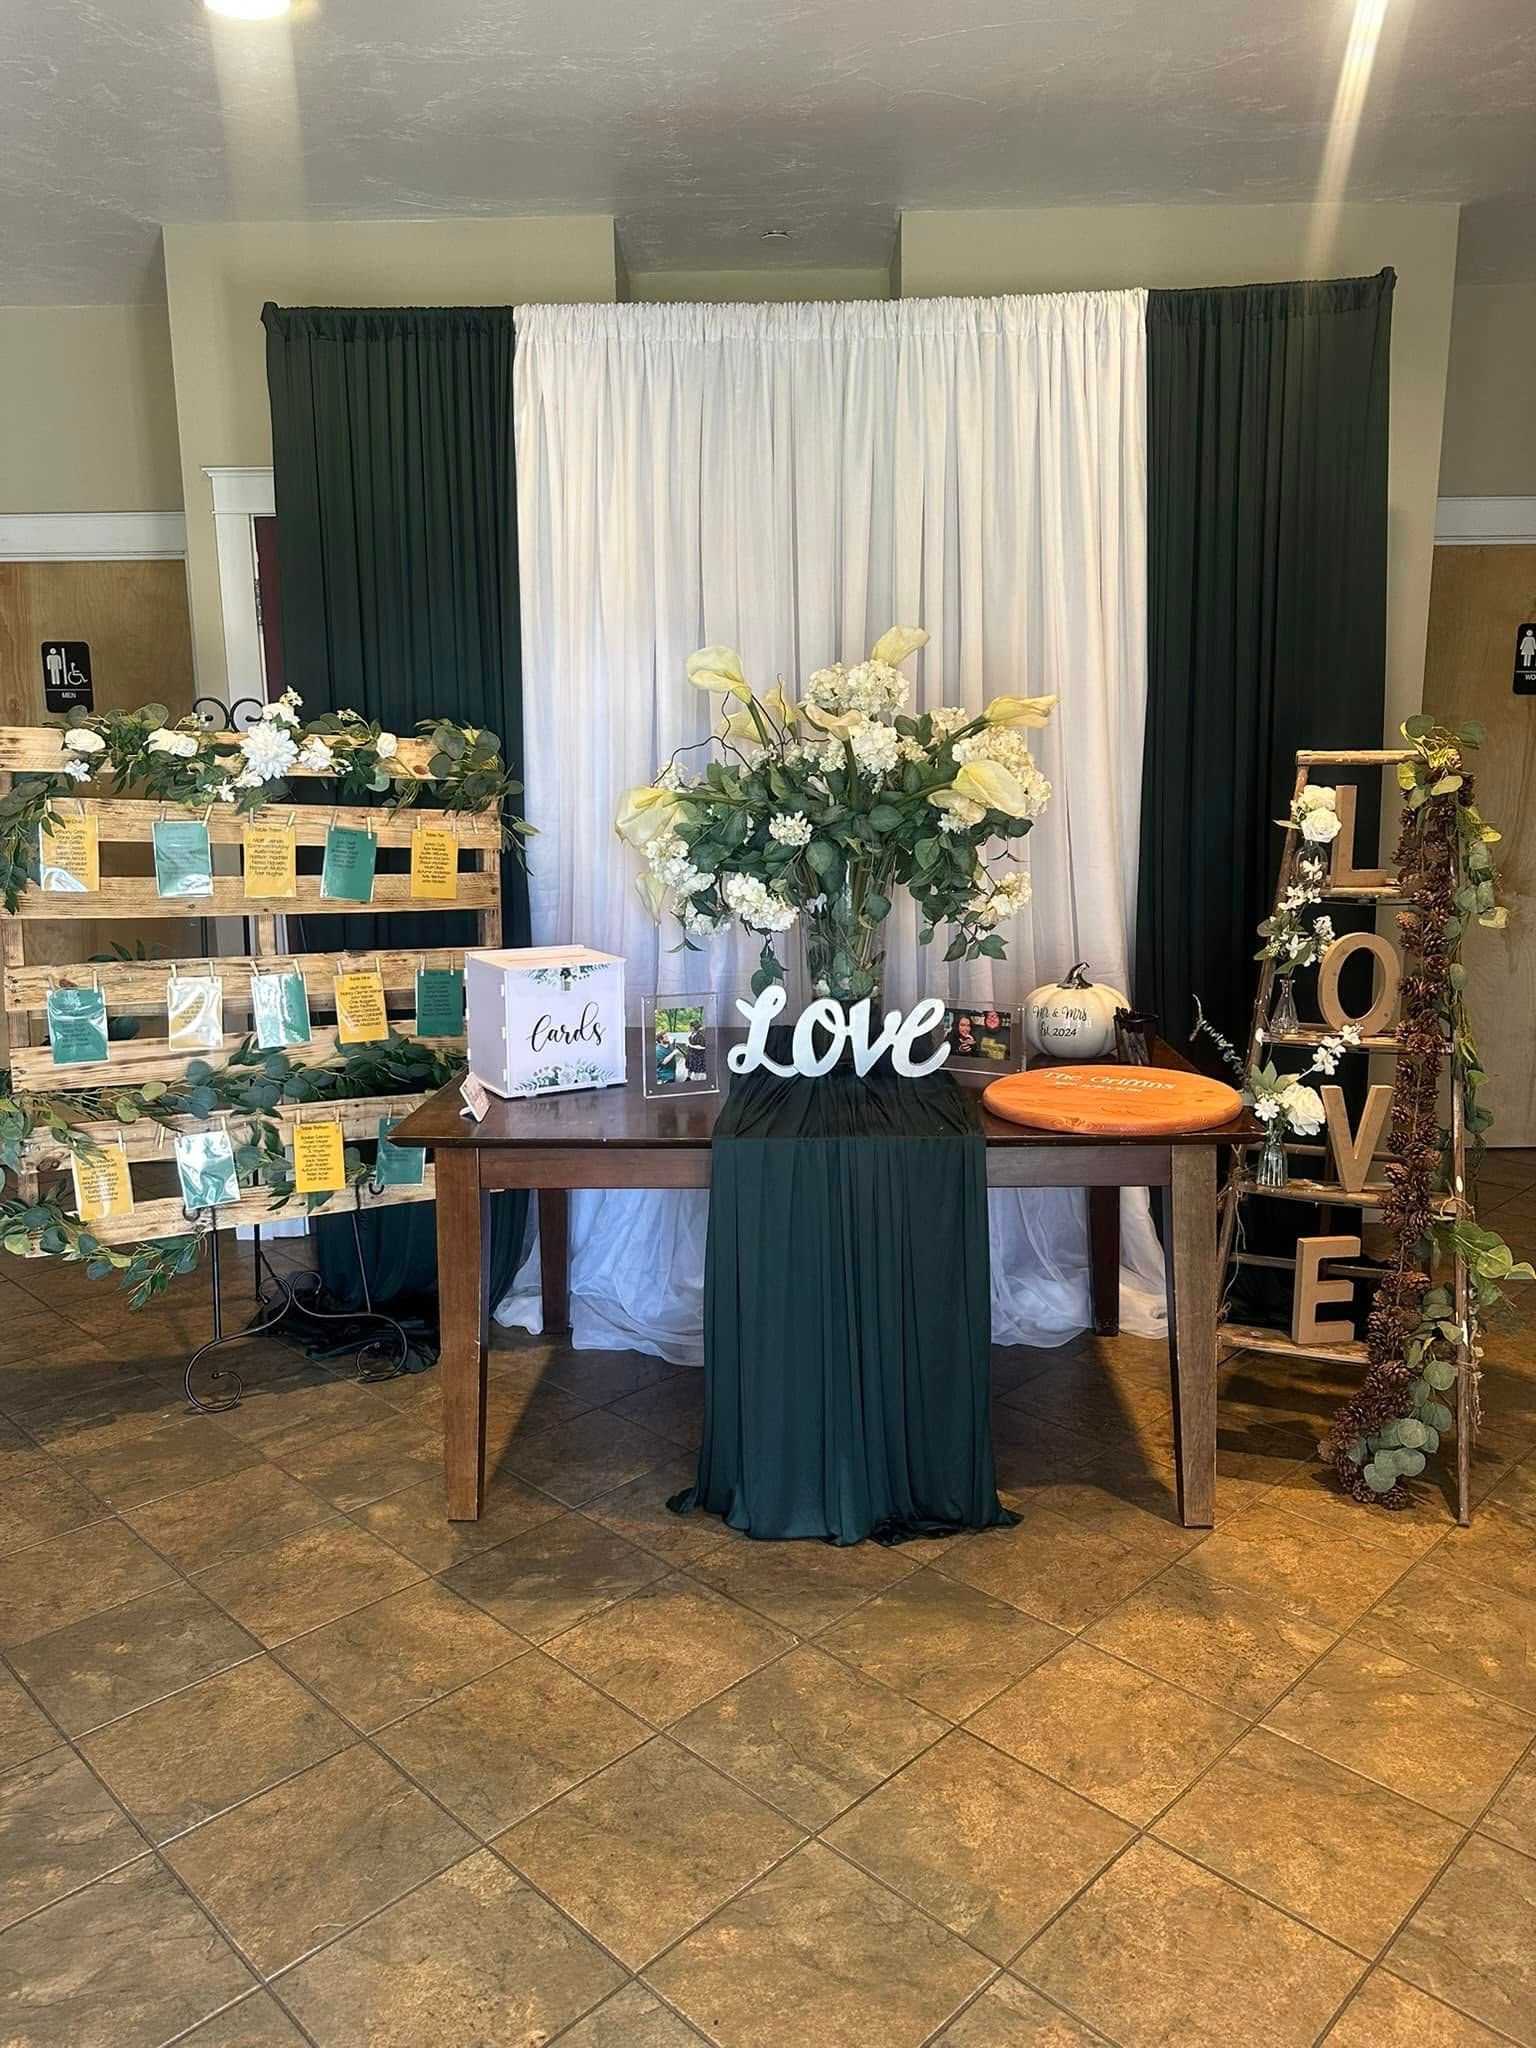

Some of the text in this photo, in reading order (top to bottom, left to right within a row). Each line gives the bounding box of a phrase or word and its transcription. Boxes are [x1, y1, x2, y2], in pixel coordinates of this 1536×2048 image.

[1032, 1005, 1088, 1022] Mr & Mrs
[526, 1001, 604, 1053] Cards
[1053, 1028, 1077, 1037] 2024
